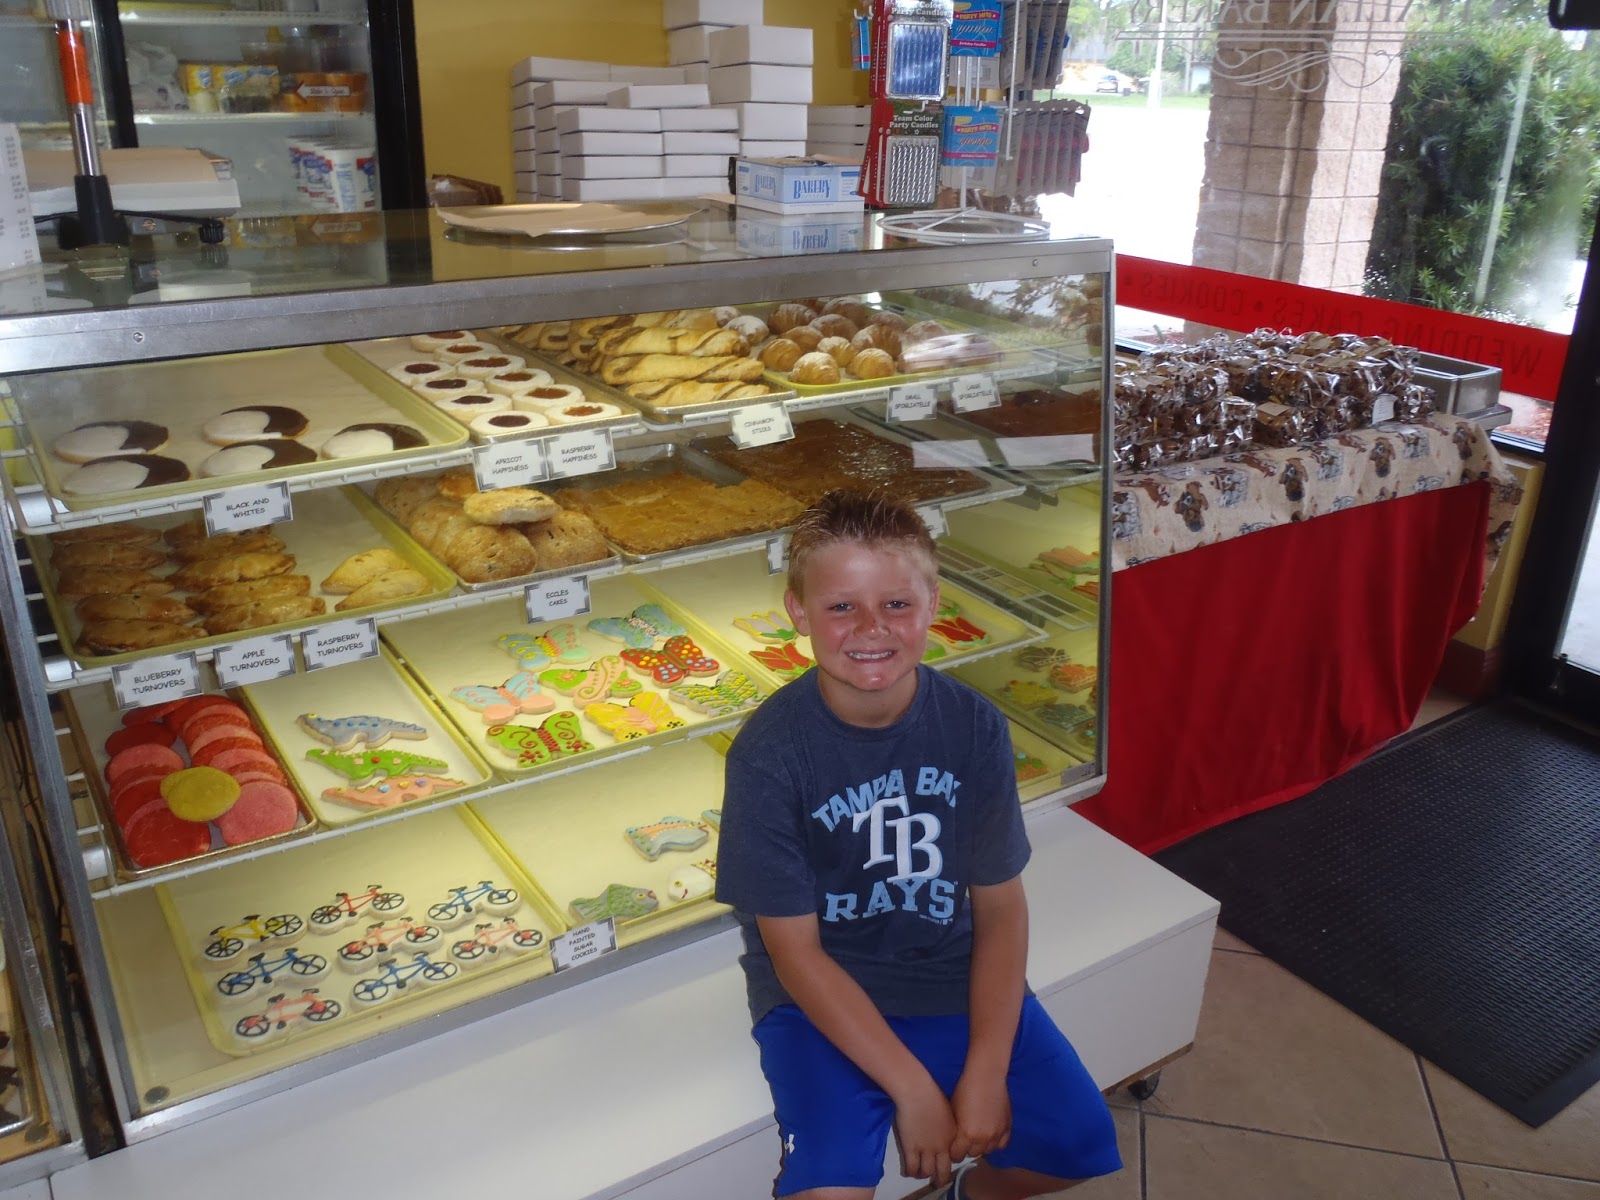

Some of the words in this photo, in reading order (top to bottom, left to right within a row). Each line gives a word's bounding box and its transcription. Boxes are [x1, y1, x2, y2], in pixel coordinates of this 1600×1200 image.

[889, 122, 909, 130] Party
[793, 179, 832, 200] BAKERY
[561, 444, 596, 455] RASPBERRY
[495, 455, 523, 465] APRICOT
[562, 453, 598, 463] HAPPINESS
[492, 464, 529, 474] HAPPINESS
[225, 501, 250, 511] BLACK
[232, 507, 266, 518] WHITES
[545, 589, 569, 599] ECCLES
[548, 598, 568, 607] CAKES
[317, 631, 361, 647] RASPBERRY
[241, 648, 266, 660] APPLE
[317, 641, 364, 657] TURNOVERS
[229, 656, 281, 673] TURNOVERS
[133, 667, 182, 684] BLUEBERRY
[132, 677, 186, 695] TURNOVERS
[811, 769, 906, 832] TAMPA
[852, 794, 943, 884] TB
[822, 877, 955, 922] RAYS
[572, 926, 591, 937] HAND
[568, 932, 596, 946] PAINTED
[573, 941, 594, 953] SUGAR
[571, 947, 598, 961] COOKIES
